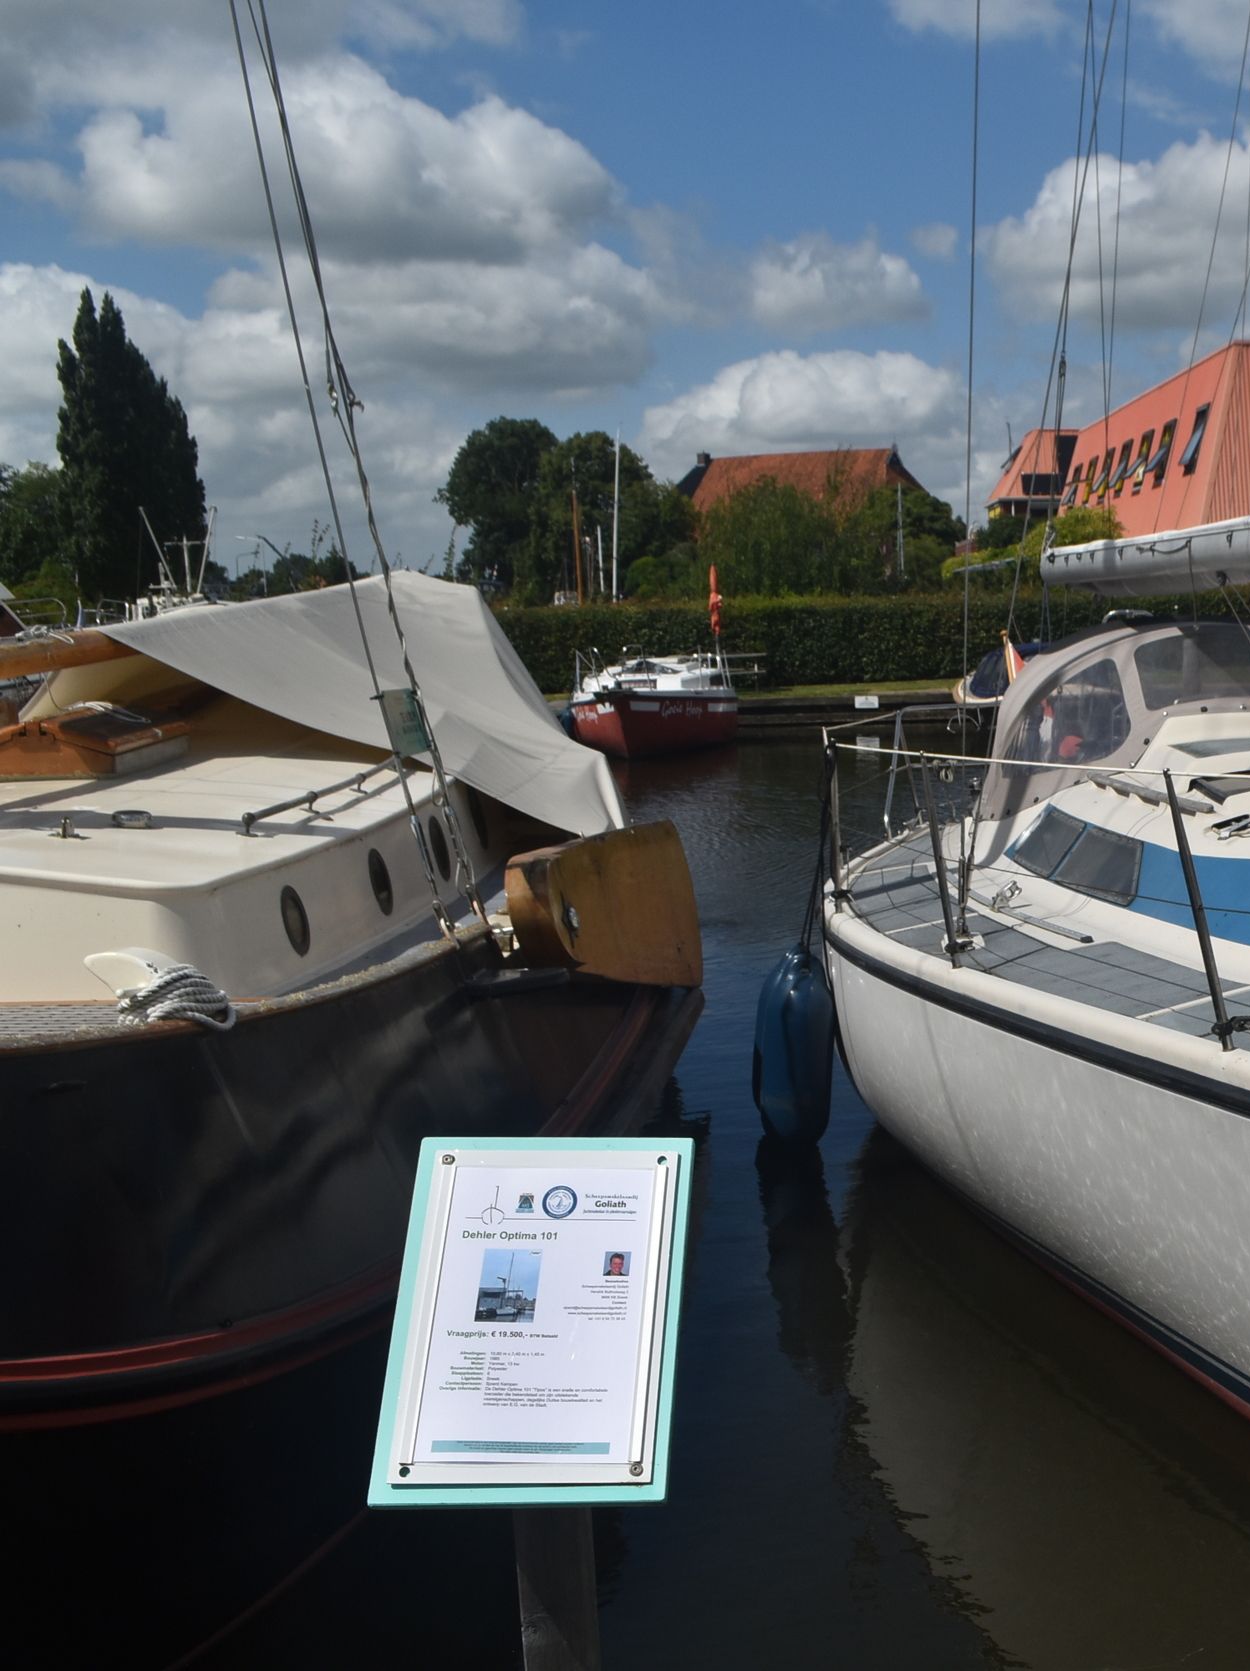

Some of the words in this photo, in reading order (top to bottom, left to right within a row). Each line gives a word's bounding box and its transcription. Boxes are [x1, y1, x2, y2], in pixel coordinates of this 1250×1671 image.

[595, 1200, 626, 1208] Goliath
[462, 1231, 497, 1239] Dehler
[500, 1231, 537, 1241] Optima
[540, 1232, 558, 1240] 101
[447, 1330, 489, 1338] Vraagprijs:
